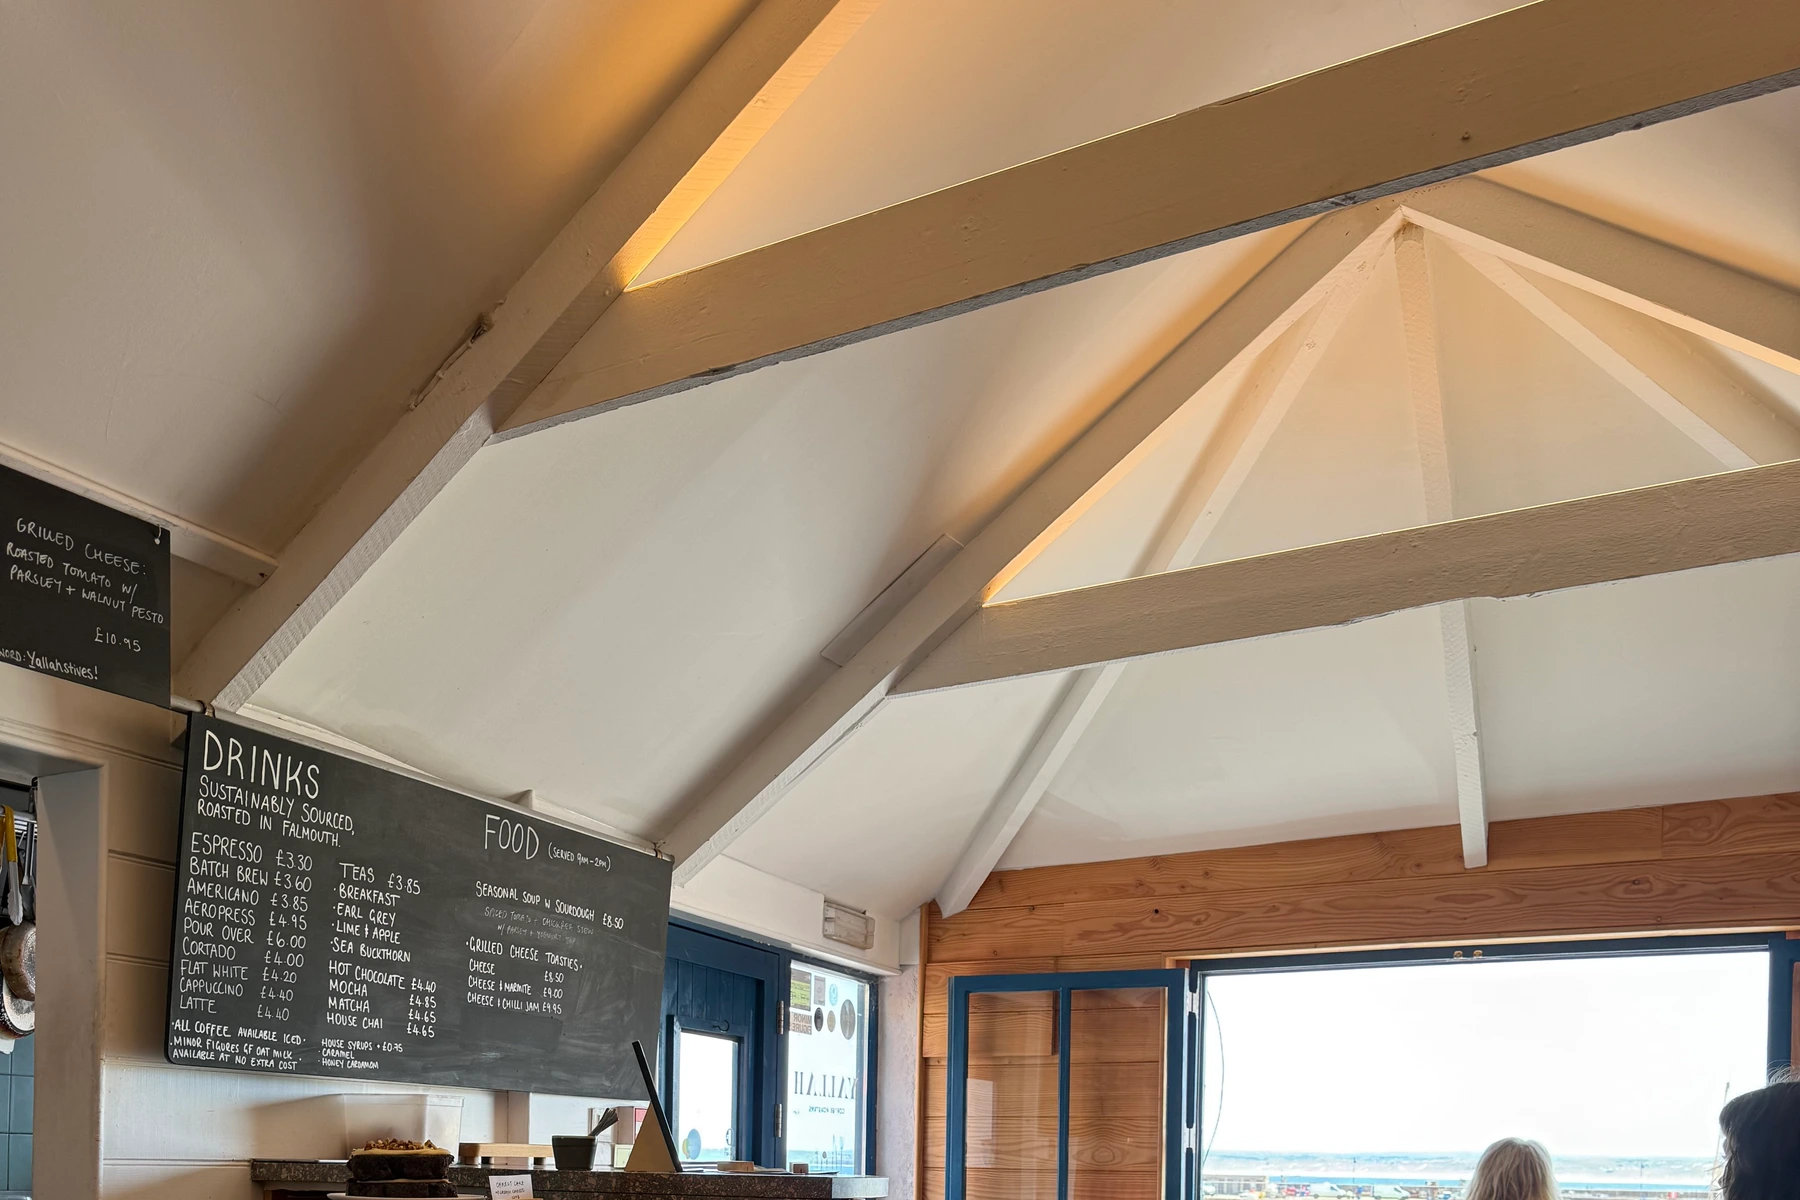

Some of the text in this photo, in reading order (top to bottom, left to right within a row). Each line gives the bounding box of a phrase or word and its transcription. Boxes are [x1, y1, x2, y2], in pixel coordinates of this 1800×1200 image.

[17, 518, 146, 575] GRILLED CHEESE:
[6, 542, 138, 604] ROASTED TOMATO W/
[10, 564, 164, 624] PARSLEY + WALNUT PESTO
[94, 627, 141, 652] £10.95
[26, 650, 98, 680] Yallahstives!
[203, 730, 320, 799] DRINKS
[199, 774, 355, 836] SUSTAINABLY SOURCED,
[197, 798, 341, 848] ROASTED IN FALMOUTH.
[484, 813, 540, 860] FOOD
[548, 841, 575, 862] (SERVED
[191, 832, 313, 872] ESPRESSO £3.30
[190, 856, 312, 893] BATCH BREW £3.60
[339, 862, 421, 895] TEAS £3.85
[187, 877, 308, 912] AMERICANO £3.85
[339, 882, 401, 907] BREAKFAST
[475, 880, 519, 901] SEASONAL
[522, 891, 541, 905] SOUP
[555, 899, 595, 921] SOURDOUGH
[602, 912, 625, 930] £8.50
[184, 898, 307, 930] AEROPRESS £4.95
[337, 902, 396, 928] EARL GREY
[184, 917, 306, 949] POUR OVER £6.00
[336, 919, 361, 937] LIME
[372, 927, 401, 945] APPLE
[183, 936, 304, 968] CORTADO £4.00
[332, 936, 411, 963] SEA BUCKTHORN
[469, 936, 579, 971] GRILLED CHEESE TOASTIES
[181, 959, 297, 983] FLAT WHITE £4.20
[328, 959, 437, 993] HOT CHOCOLATE £4.40
[469, 958, 564, 983] CHEESE £8.50
[180, 977, 294, 1001] CAPPUCCINO £4.40
[329, 978, 437, 1009] MOCHA £4.85
[468, 975, 495, 991] CHEESE
[504, 982, 532, 995] MARMITE
[543, 987, 563, 999] £9.00
[180, 995, 290, 1021] LATTE £4.40
[328, 996, 437, 1024] MATCHA £4.65
[467, 992, 494, 1007] CHEESE
[502, 998, 523, 1010] CHILLI
[525, 1001, 540, 1013] JAM
[542, 1002, 562, 1015] £9.95
[174, 1019, 302, 1045] ALL COFFEE AVAILABLE ICED
[326, 1011, 435, 1038] HOUSE CHAI £4.65
[172, 1048, 298, 1070] AVAILABLE AT NO EXTRA COST
[174, 1036, 293, 1060] MINOR FIGURES GF OAT MILK
[321, 1038, 345, 1049] HOUSE
[347, 1040, 373, 1051] SYRUPS
[322, 1048, 355, 1060] CARAMEL
[322, 1058, 379, 1069] HONEY CARDAMOM
